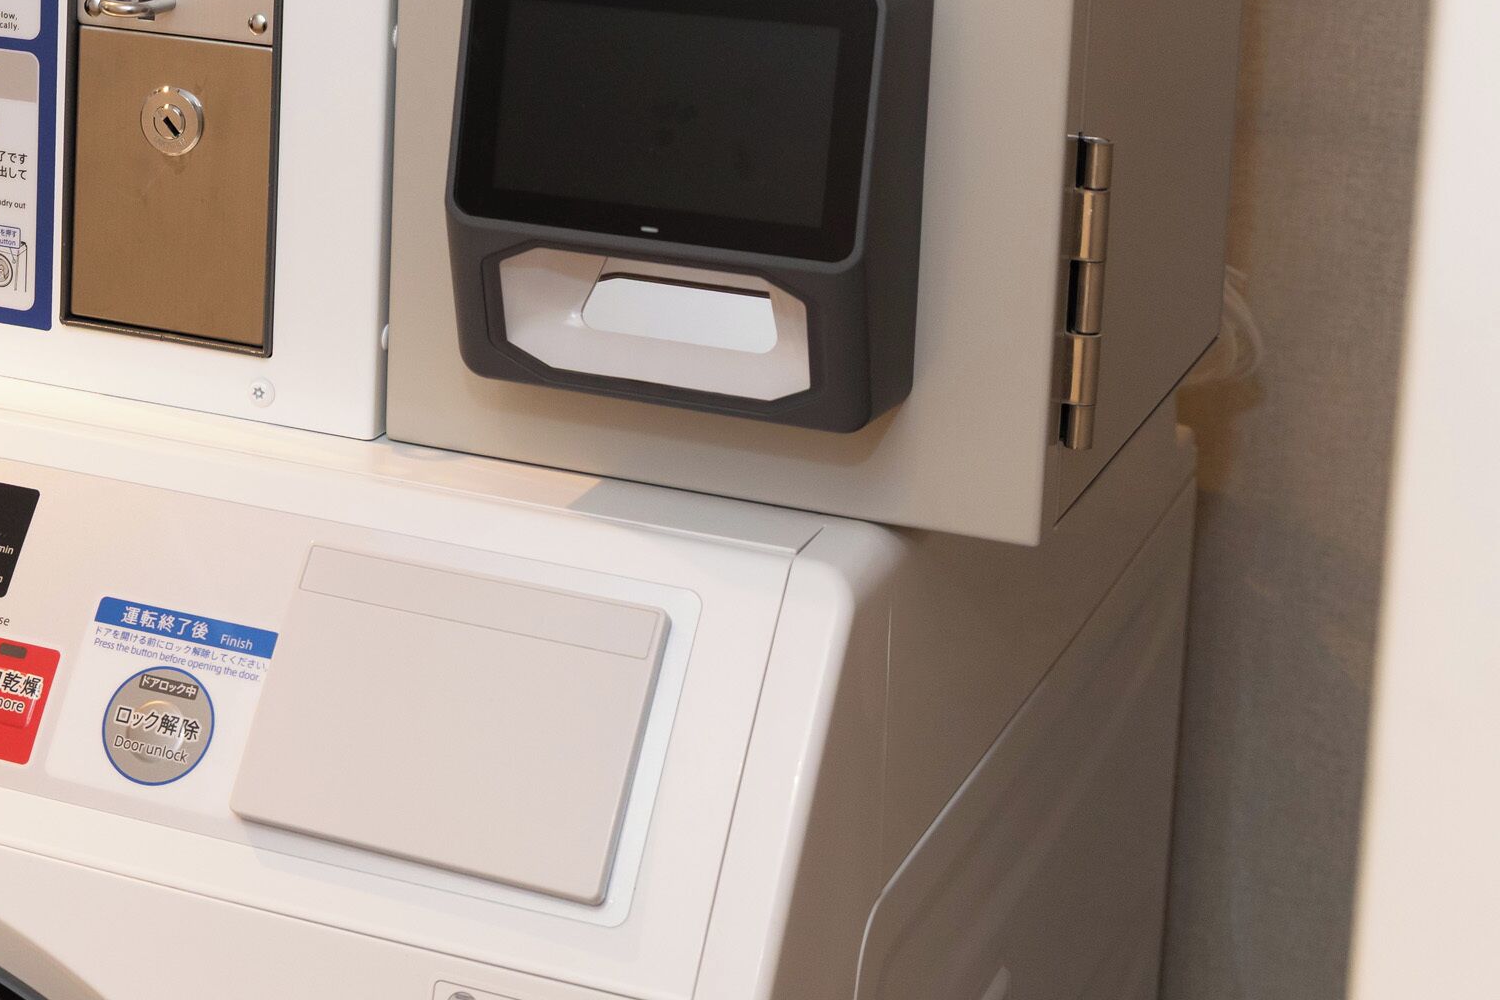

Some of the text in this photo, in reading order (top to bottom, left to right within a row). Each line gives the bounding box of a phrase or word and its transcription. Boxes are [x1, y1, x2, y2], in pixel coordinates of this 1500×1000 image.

[120, 606, 253, 650] 運転終了後 Finish
[141, 675, 197, 697] ドアロック中
[115, 706, 200, 741] ロック解除
[114, 735, 188, 763] Door unlock
